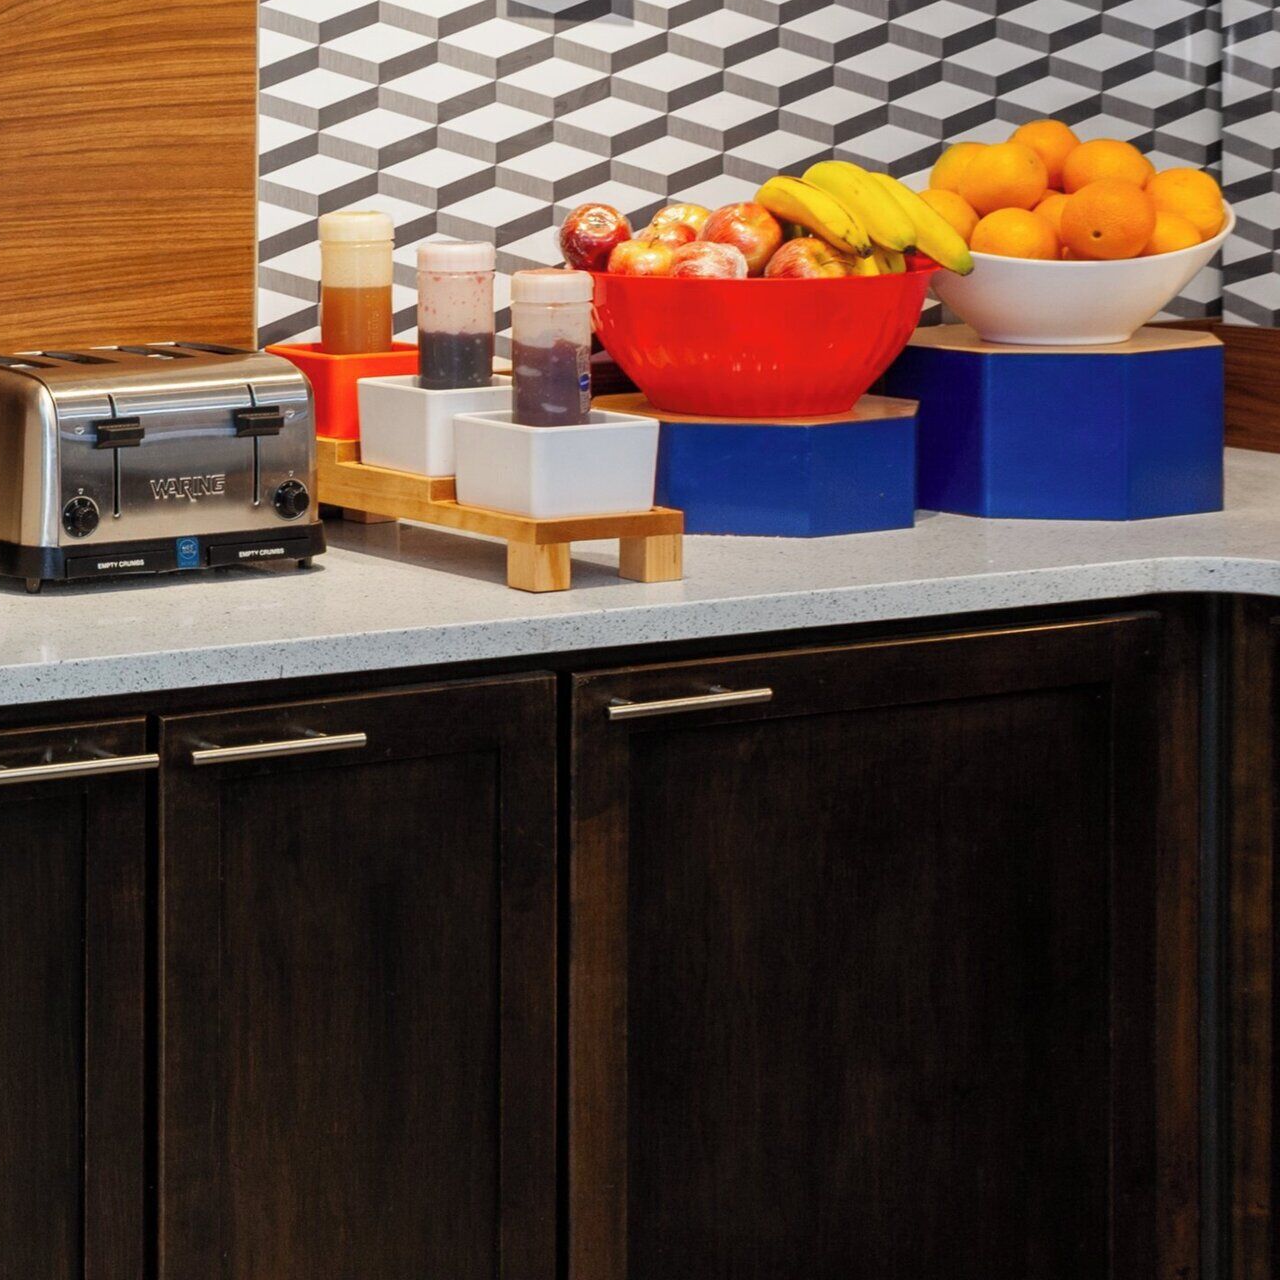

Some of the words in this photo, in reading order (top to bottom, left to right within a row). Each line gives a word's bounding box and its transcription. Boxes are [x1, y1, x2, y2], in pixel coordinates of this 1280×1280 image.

[150, 474, 226, 502] WARING
[239, 549, 258, 558] EMPTY
[260, 547, 285, 556] CRUMBS
[97, 561, 117, 570] EMPTY
[119, 558, 145, 568] CRUMBS
